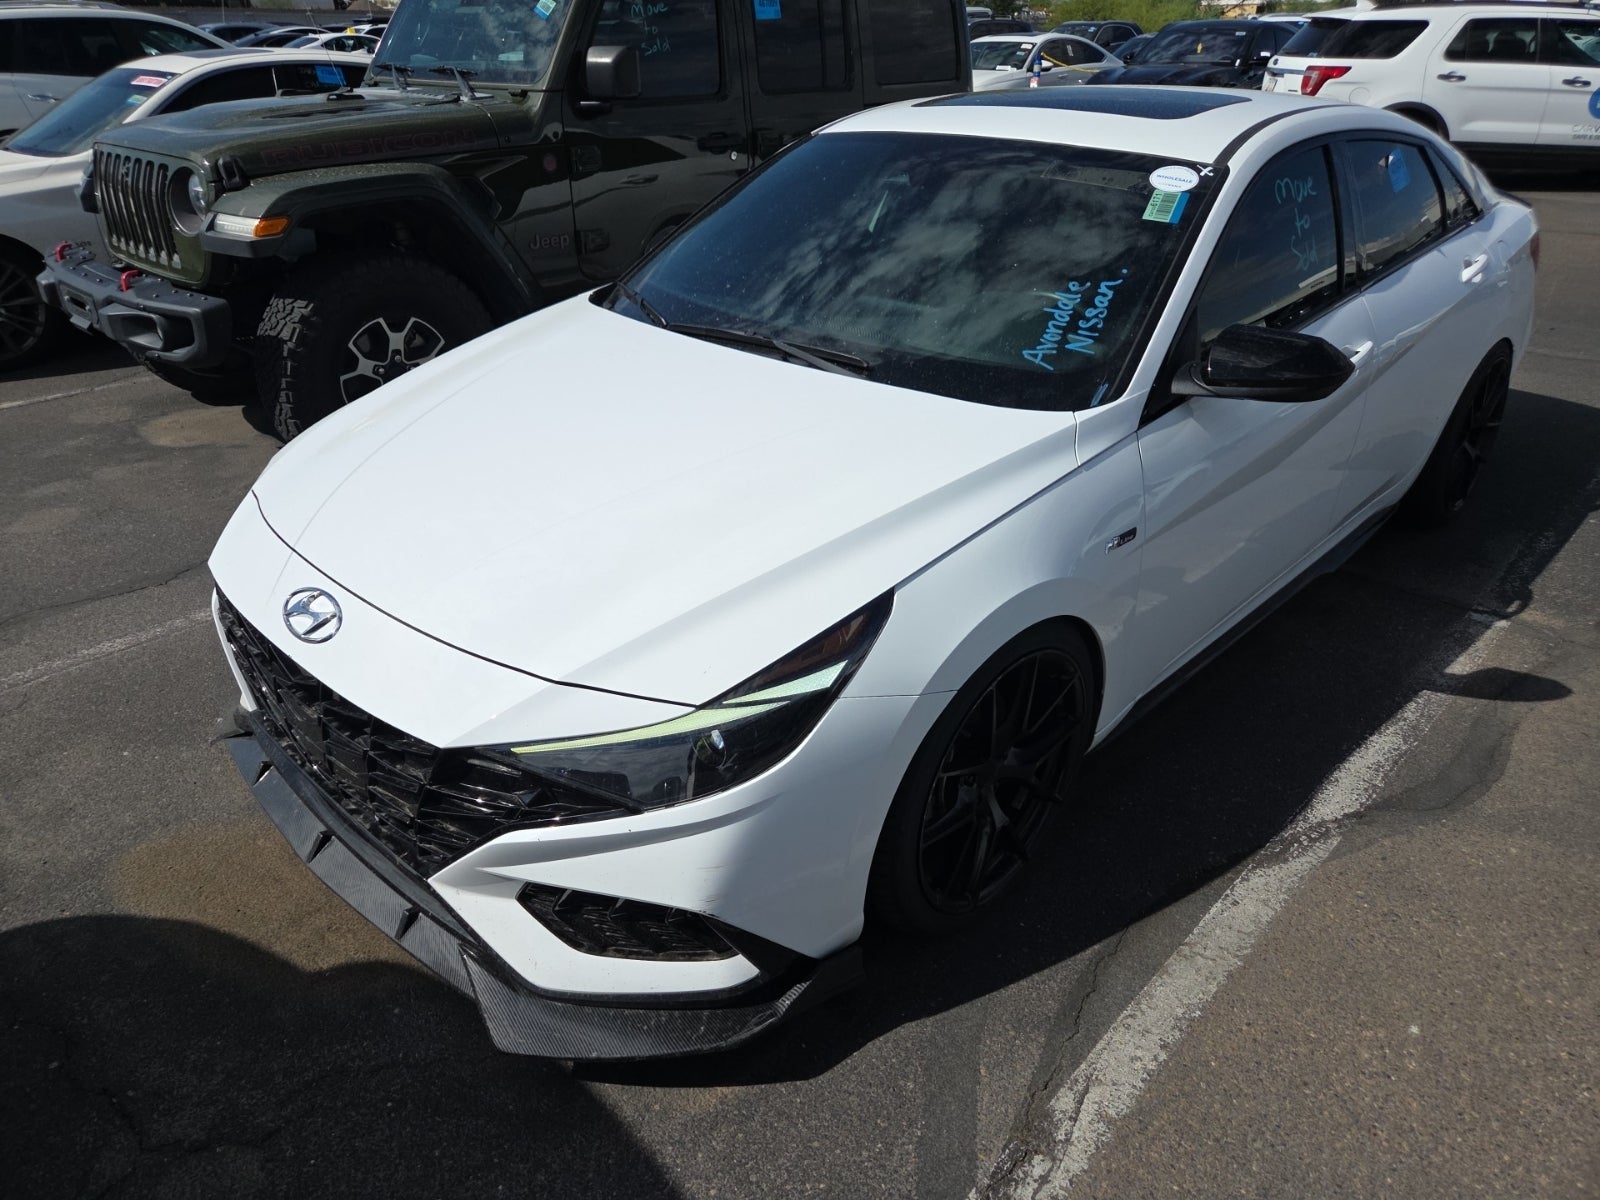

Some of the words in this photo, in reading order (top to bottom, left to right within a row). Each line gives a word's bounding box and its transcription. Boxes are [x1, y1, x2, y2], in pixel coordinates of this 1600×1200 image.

[261, 128, 479, 168] RUBICON
[1156, 174, 1193, 184] WHOLESALE
[529, 233, 570, 250] Jeep
[1022, 281, 1092, 371] Avondale
